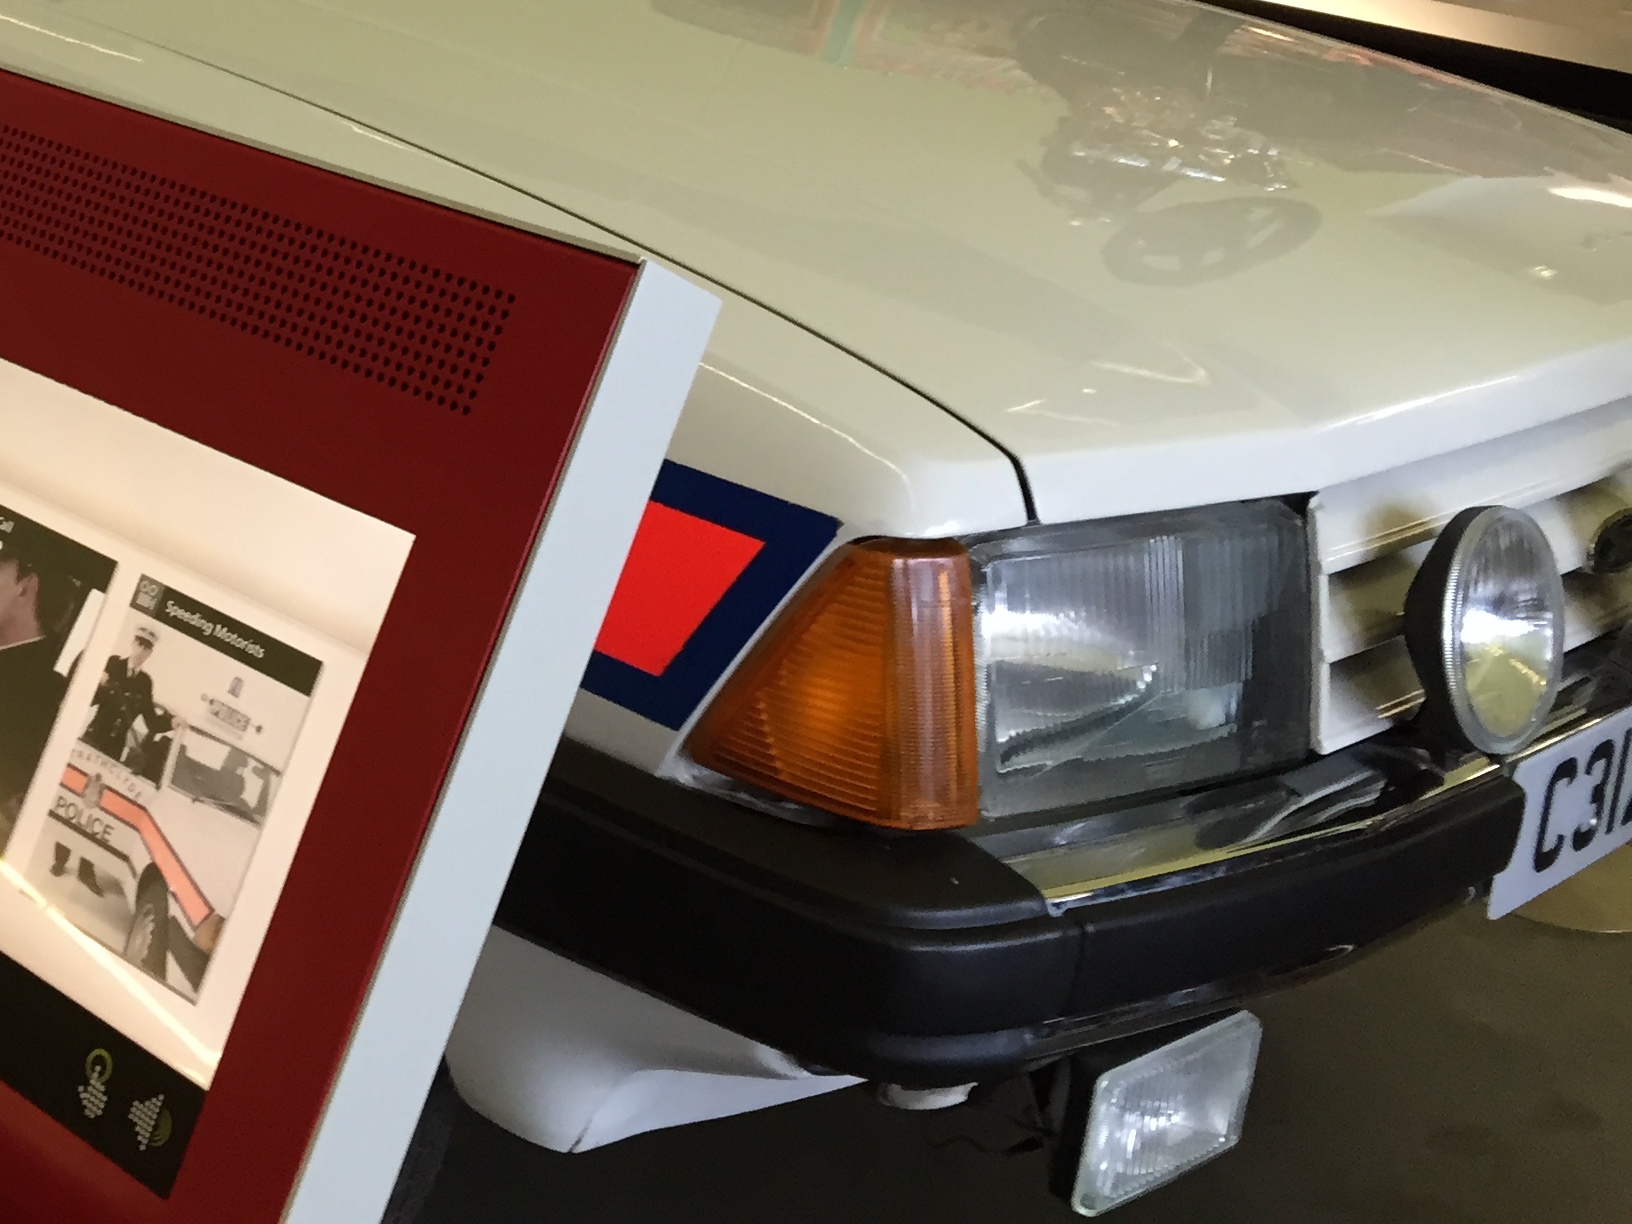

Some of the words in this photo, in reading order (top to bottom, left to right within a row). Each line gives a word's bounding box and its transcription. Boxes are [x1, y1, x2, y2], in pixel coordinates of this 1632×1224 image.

[165, 600, 215, 636] Speeding
[213, 624, 266, 658] Motorists
[53, 795, 116, 844] POLICE
[1532, 727, 1632, 873] C31
